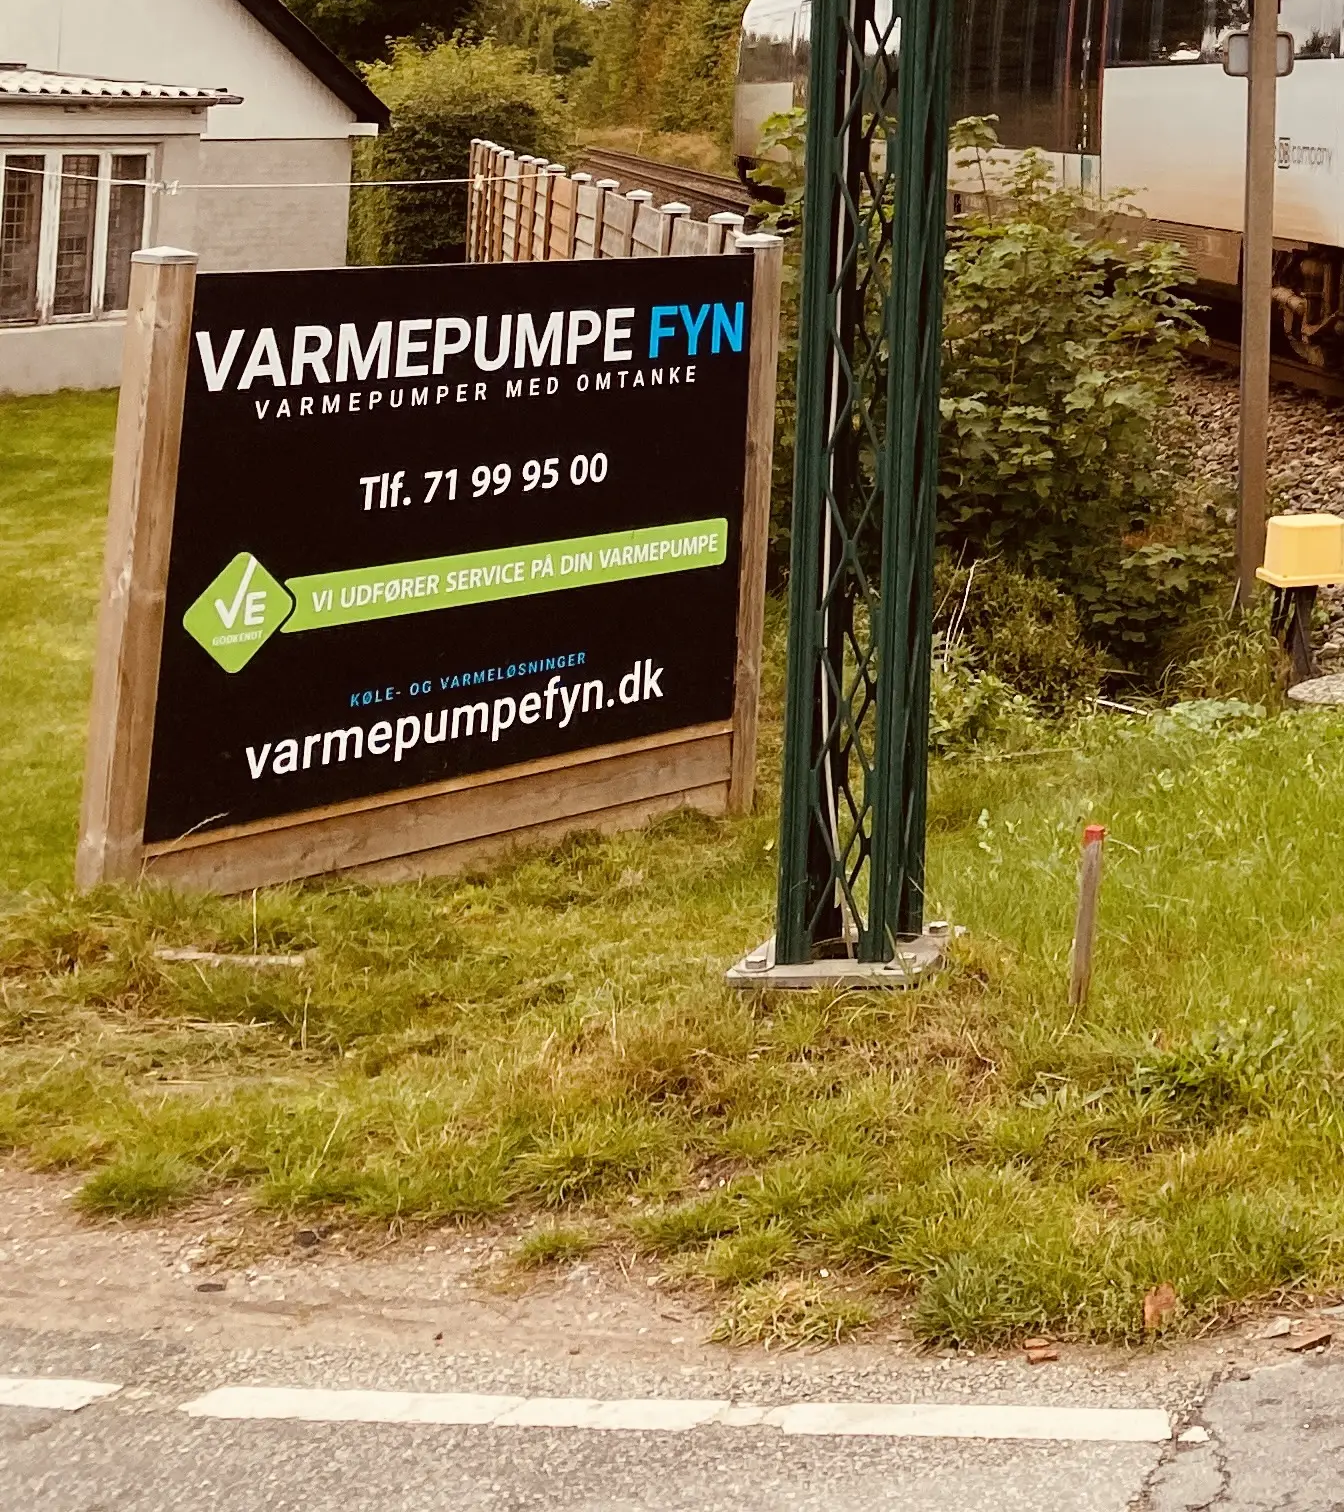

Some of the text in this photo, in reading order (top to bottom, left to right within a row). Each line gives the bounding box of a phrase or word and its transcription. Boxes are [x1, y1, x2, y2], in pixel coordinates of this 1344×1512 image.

[195, 301, 745, 392] VARMEPUMPE FYN
[254, 365, 697, 420] VARMEPUMPER MED OMTANKE
[359, 452, 608, 511] Tlf. 71 99 95 00
[311, 533, 719, 613] VI UDFØRER SERVICE PÅ DIN VARMEPUMPE
[349, 650, 587, 708] KØLE- OG VARMELØSNINGER
[244, 657, 665, 781] varmepumpefyn.dk
